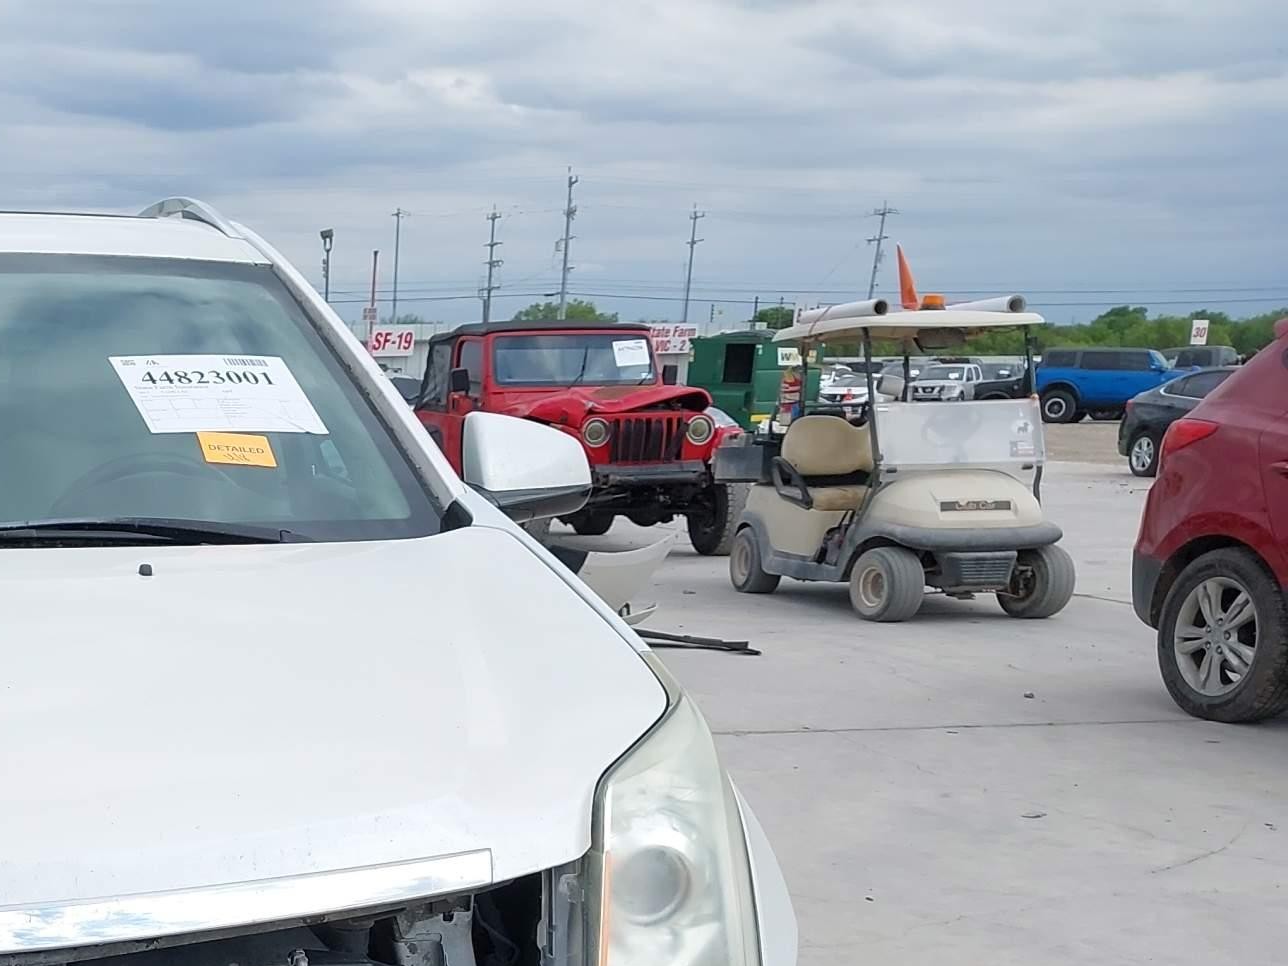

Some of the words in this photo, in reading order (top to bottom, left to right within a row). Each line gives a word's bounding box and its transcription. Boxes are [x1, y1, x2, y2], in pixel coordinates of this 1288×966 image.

[672, 326, 696, 337] Farm
[1193, 326, 1207, 338] 30
[373, 332, 413, 351] SF-19
[679, 340, 687, 352] 2
[141, 370, 277, 386] 44823001
[208, 444, 265, 454] DETAILED
